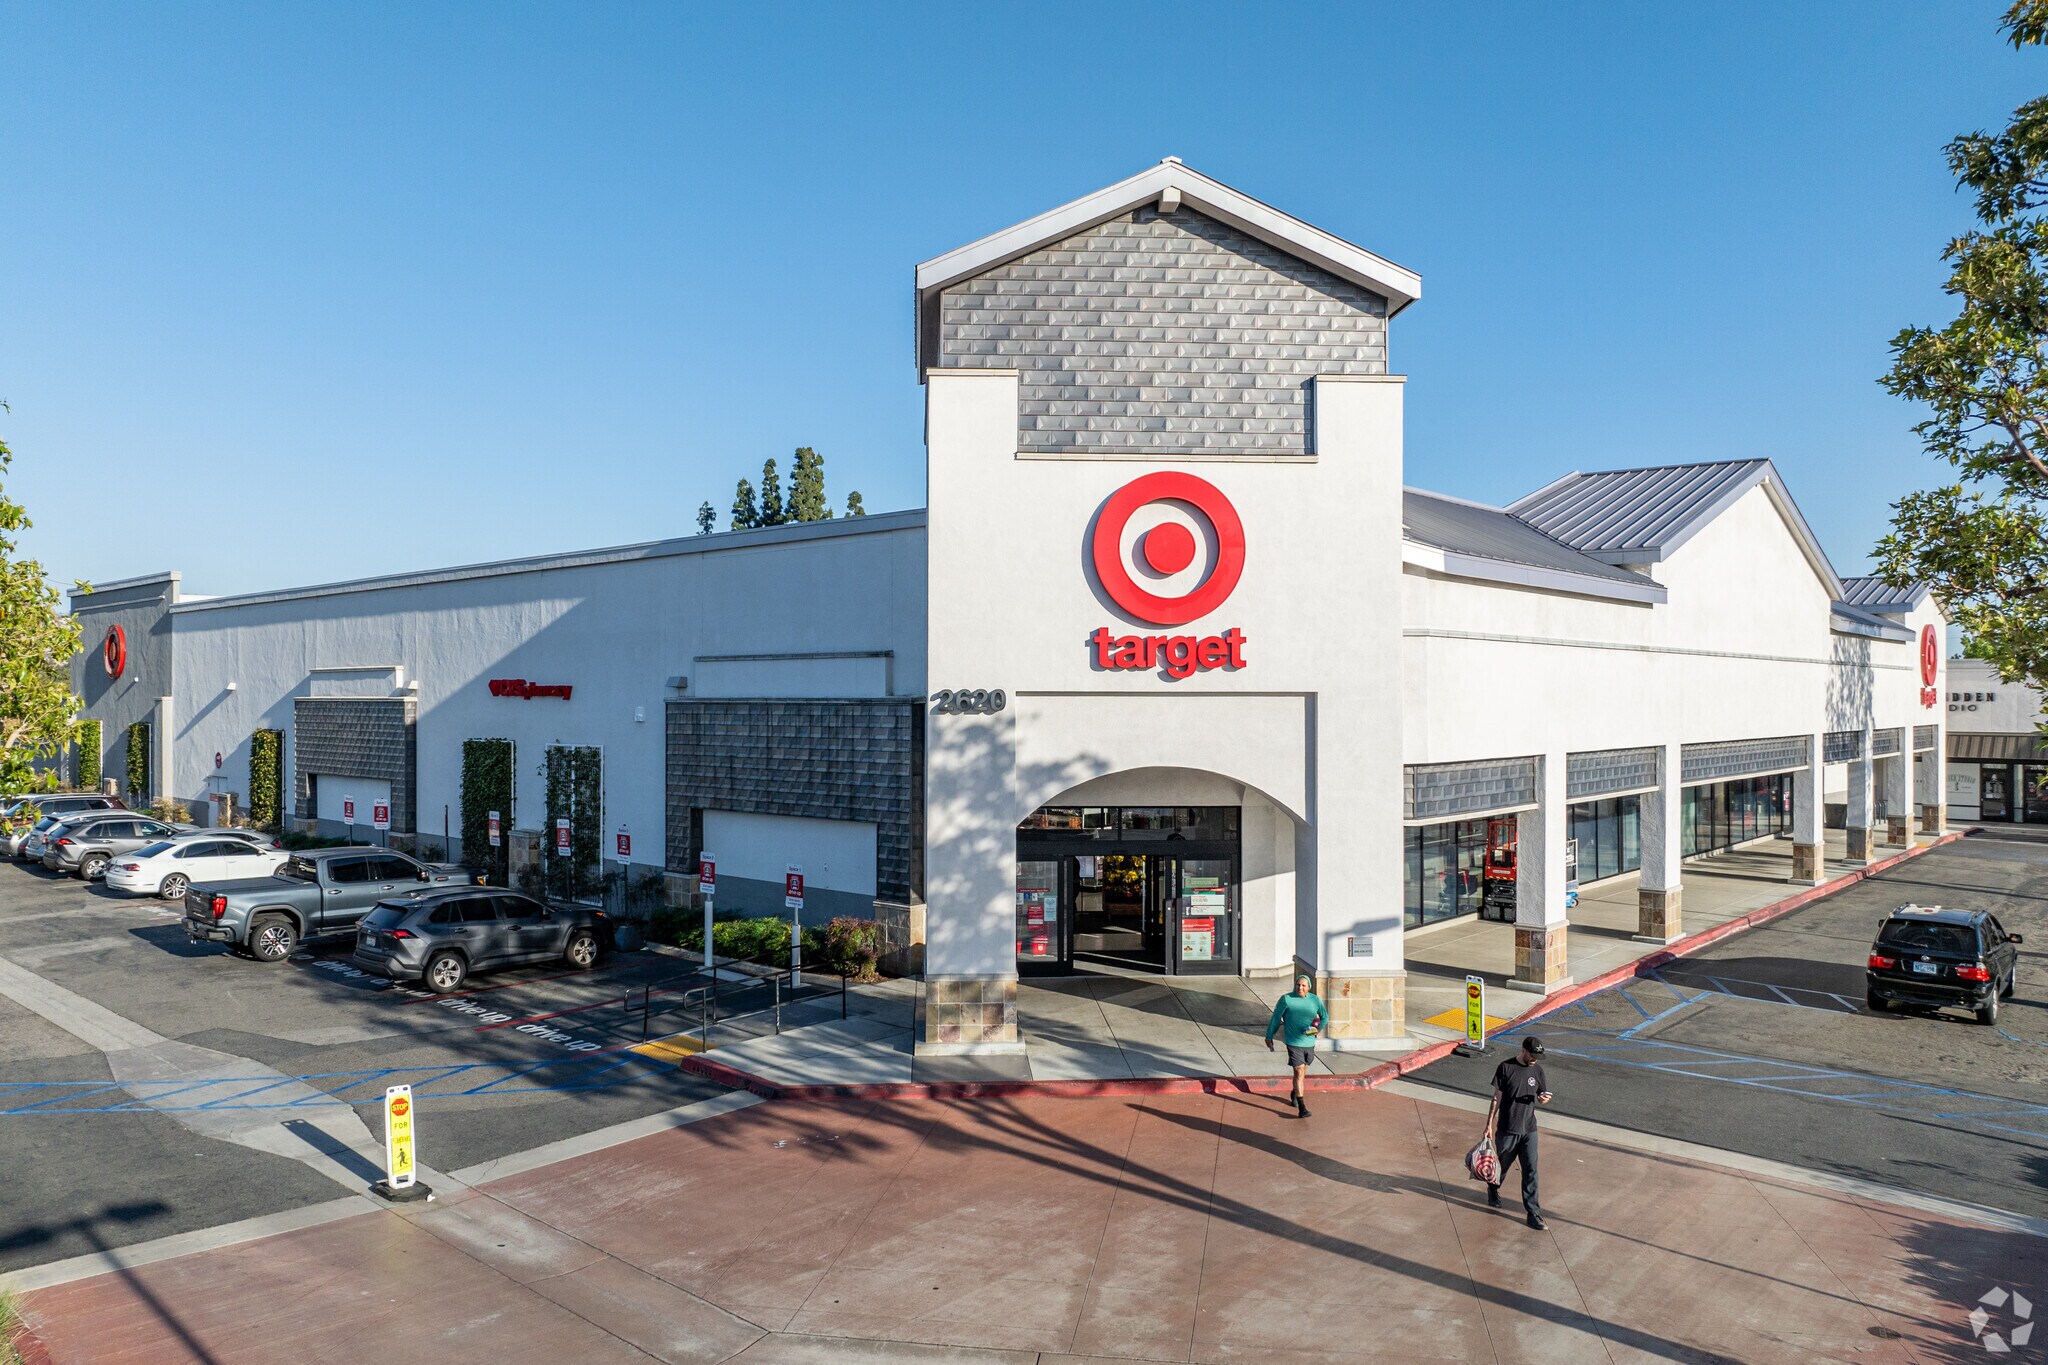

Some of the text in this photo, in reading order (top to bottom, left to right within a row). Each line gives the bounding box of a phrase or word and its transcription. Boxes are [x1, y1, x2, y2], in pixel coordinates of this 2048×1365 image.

[1094, 627, 1247, 679] target
[938, 688, 1007, 711] 2620
[437, 999, 486, 1014] drive
[516, 1024, 602, 1051] drive up
[392, 1103, 408, 1111] STOP
[394, 1122, 408, 1130] FOR
